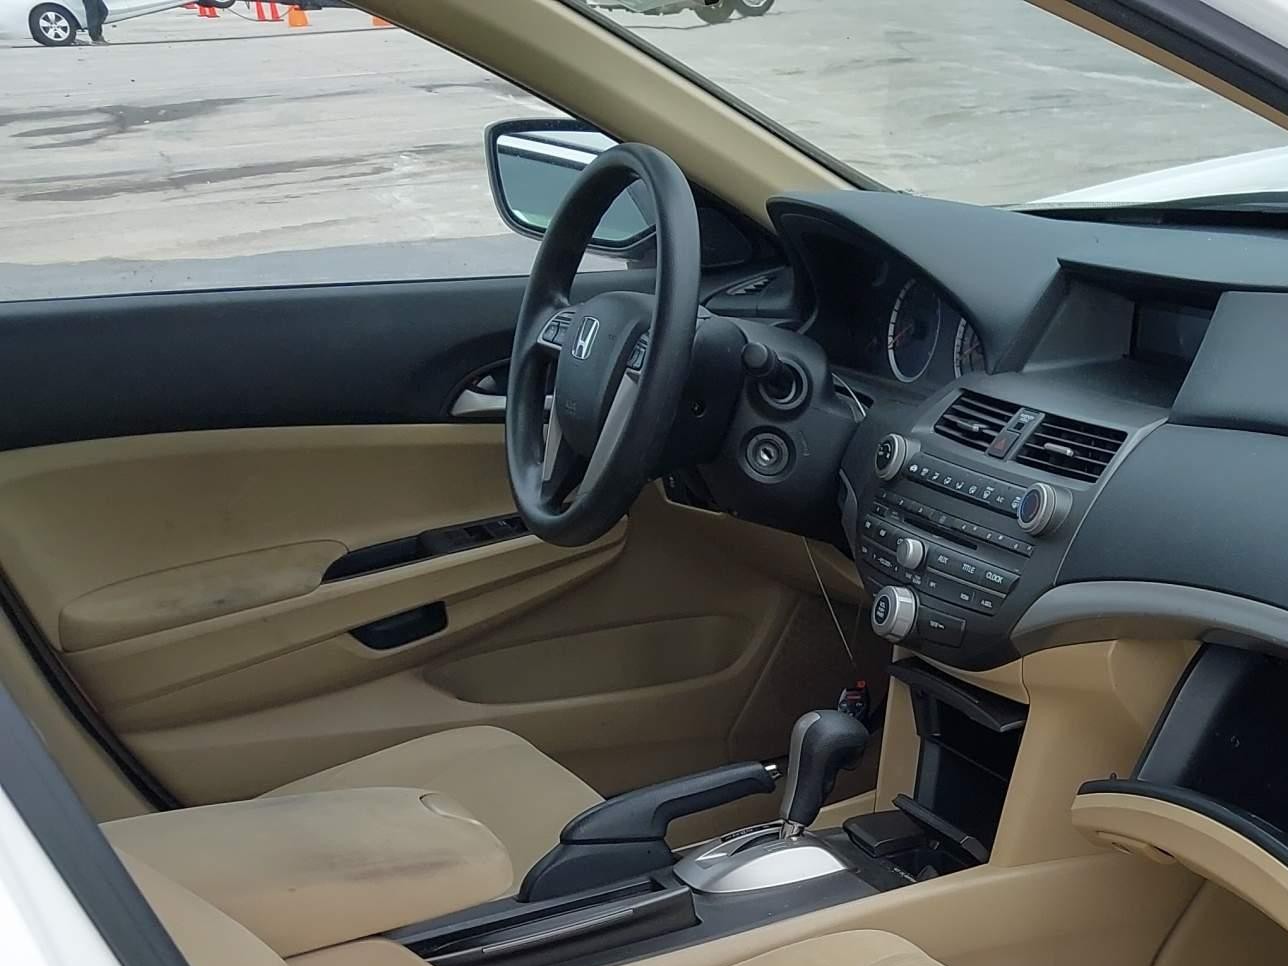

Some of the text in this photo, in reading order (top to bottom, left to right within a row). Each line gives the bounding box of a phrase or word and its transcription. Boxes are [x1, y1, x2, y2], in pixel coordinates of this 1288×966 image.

[938, 555, 949, 564] AUX
[962, 564, 976, 574] TITLE
[986, 572, 1004, 584] CLOCK
